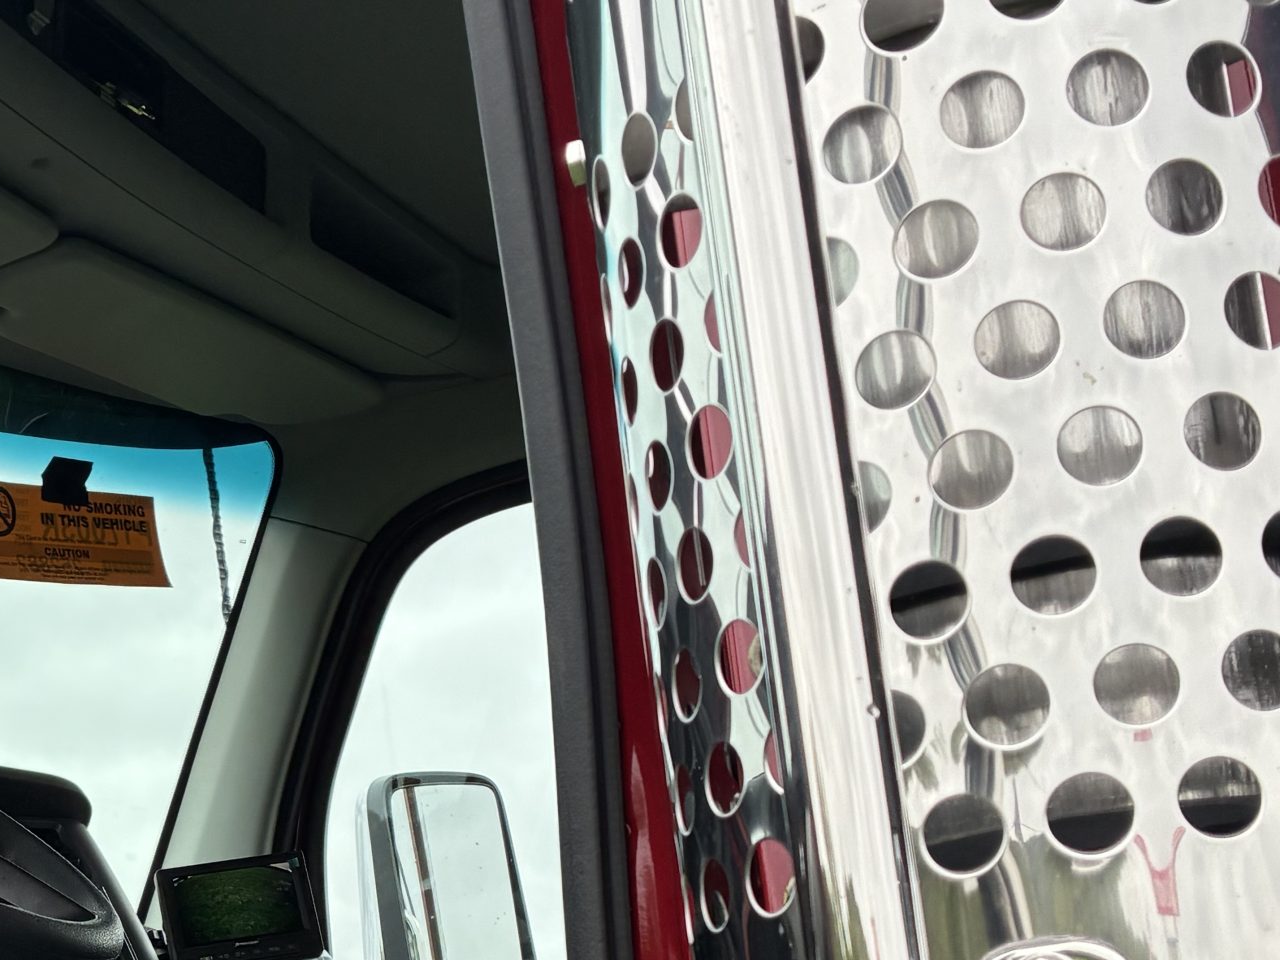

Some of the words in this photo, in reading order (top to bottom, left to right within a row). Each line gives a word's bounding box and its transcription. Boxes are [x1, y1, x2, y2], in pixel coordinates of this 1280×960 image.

[86, 502, 145, 517] SMOKING
[41, 513, 54, 525] IN
[59, 514, 89, 528] THIS
[93, 518, 148, 533] VEHICLE
[44, 547, 90, 559] CAUTION
